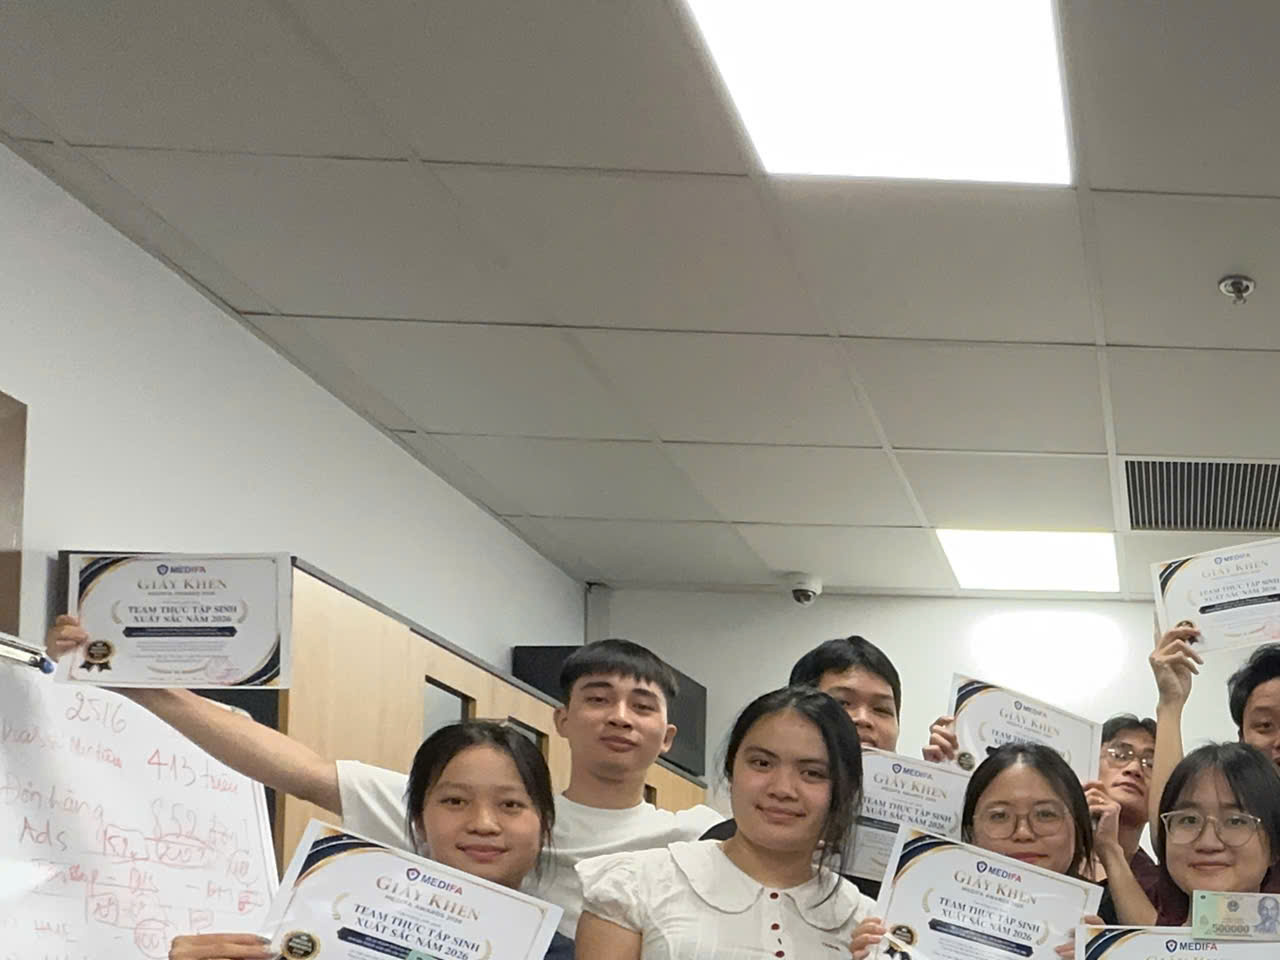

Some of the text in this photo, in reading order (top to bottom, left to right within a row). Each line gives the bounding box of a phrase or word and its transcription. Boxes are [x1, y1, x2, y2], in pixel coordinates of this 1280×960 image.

[170, 566, 207, 574] MEDIFA
[183, 578, 227, 590] KHEN
[128, 606, 157, 614] TEAM
[213, 605, 238, 614] SINH
[988, 865, 1022, 883] MEDIFA
[421, 874, 463, 896] MEDIFA
[996, 884, 1037, 905] KHEN
[429, 893, 480, 921] KHEN
[940, 896, 967, 911] TEAM
[1018, 920, 1040, 933] SINH
[354, 904, 388, 920] TEAM
[454, 936, 481, 953] SINH
[1012, 930, 1032, 941] 2026
[444, 946, 470, 960] 2026
[1180, 942, 1218, 951] MEDIFA
